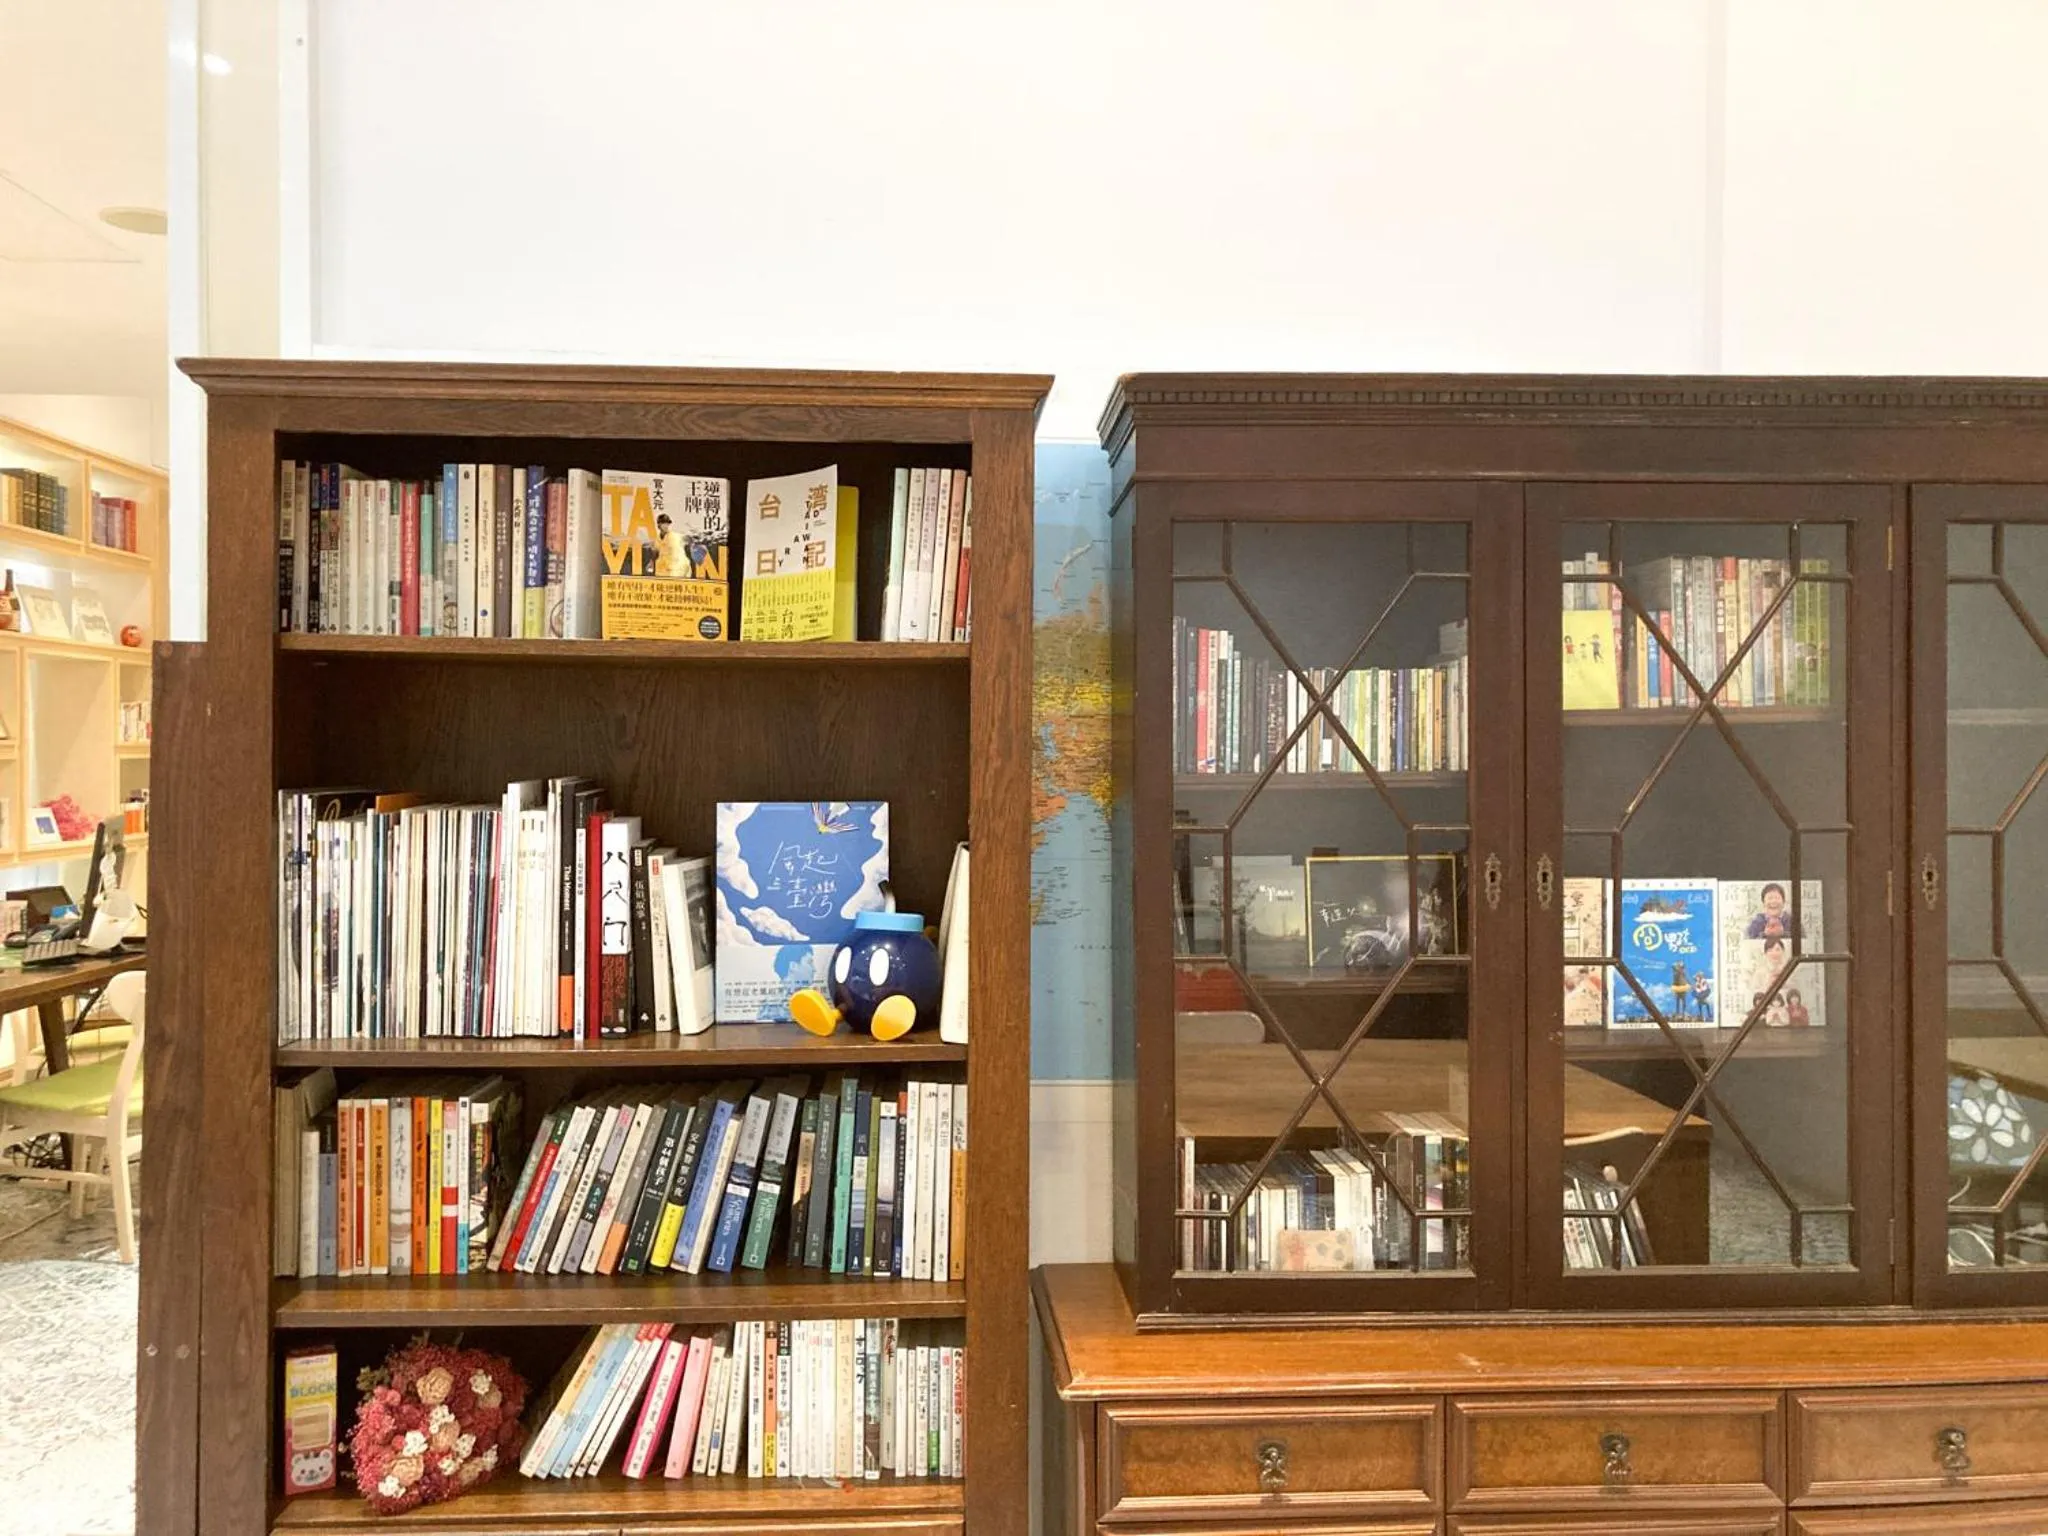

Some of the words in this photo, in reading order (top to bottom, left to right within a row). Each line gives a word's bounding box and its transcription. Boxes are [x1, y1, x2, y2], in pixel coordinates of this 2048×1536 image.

[653, 478, 664, 511] 官大元
[684, 480, 703, 514] 王牌
[703, 480, 722, 532] 逆轉的
[563, 865, 572, 881] This
[563, 881, 572, 911] Moment
